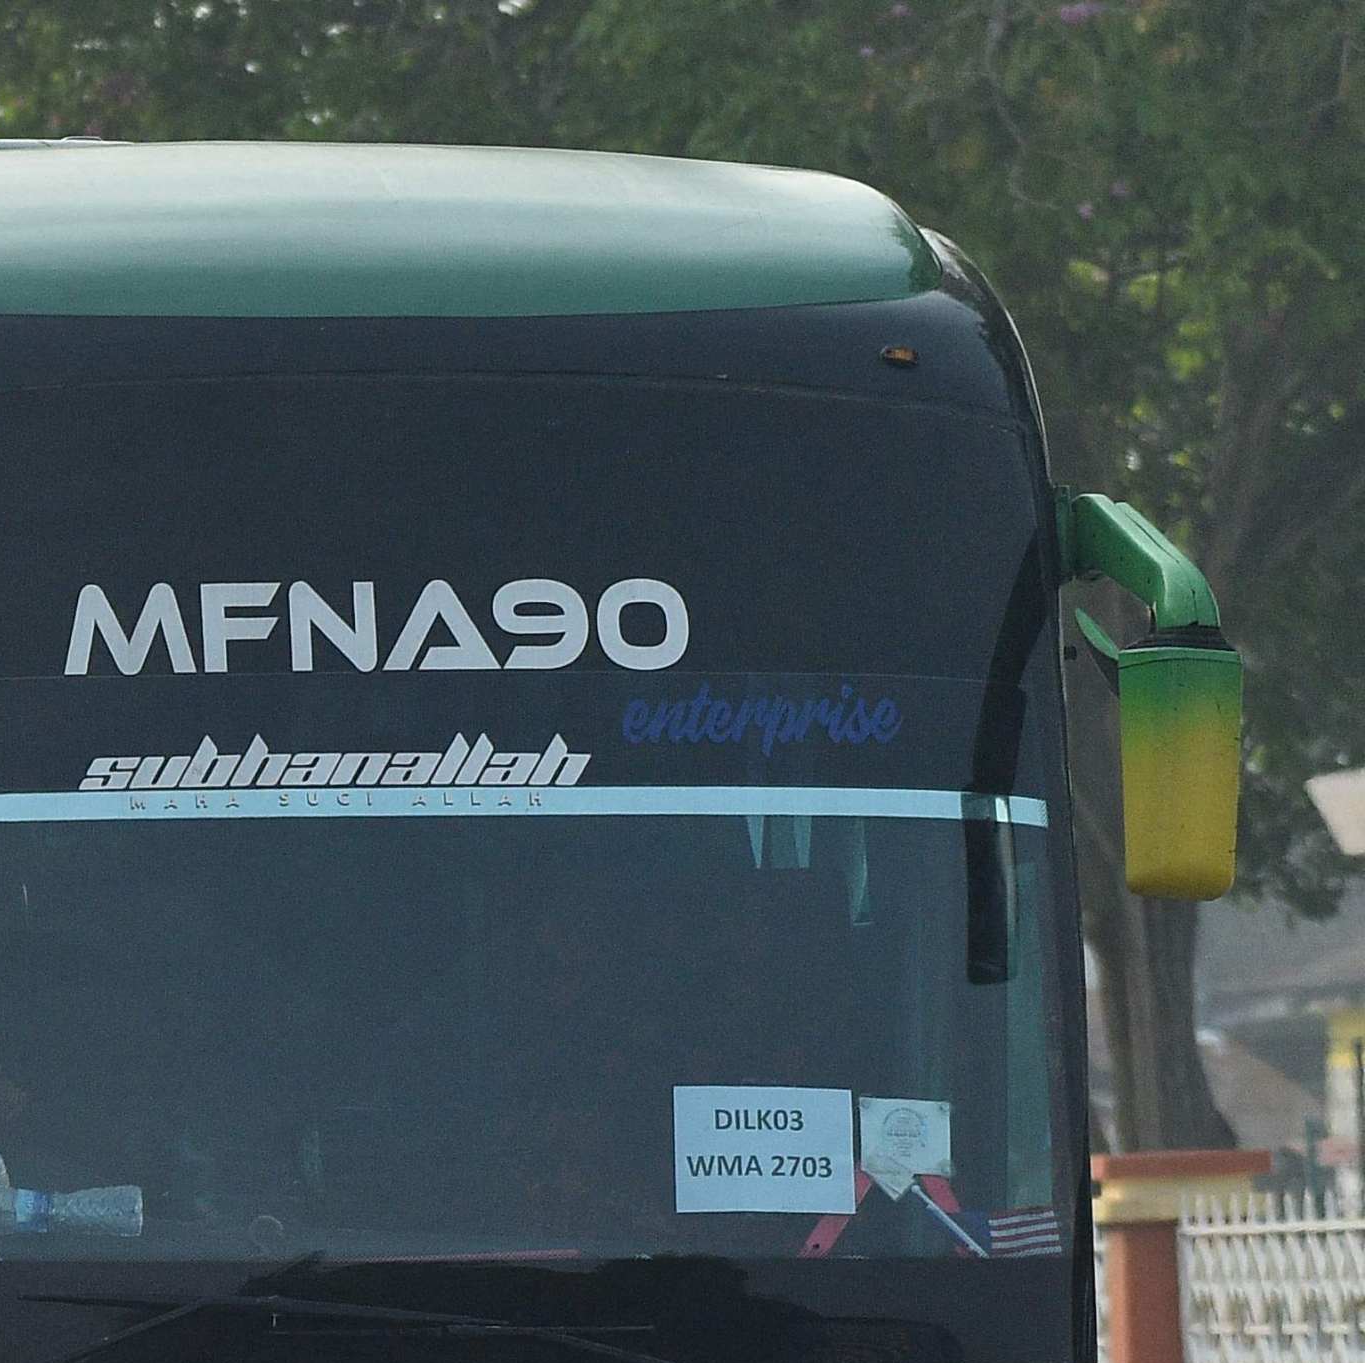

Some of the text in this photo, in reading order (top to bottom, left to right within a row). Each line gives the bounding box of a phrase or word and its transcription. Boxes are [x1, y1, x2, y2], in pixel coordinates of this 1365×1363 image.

[64, 577, 689, 676] MFNA90
[621, 683, 904, 757] enterprise
[78, 732, 592, 790] subhanallah
[278, 792, 374, 808] SUCI
[413, 791, 544, 808] ALLAH
[714, 1108, 805, 1132] DILK03
[686, 1155, 834, 1179] WMA 2703
